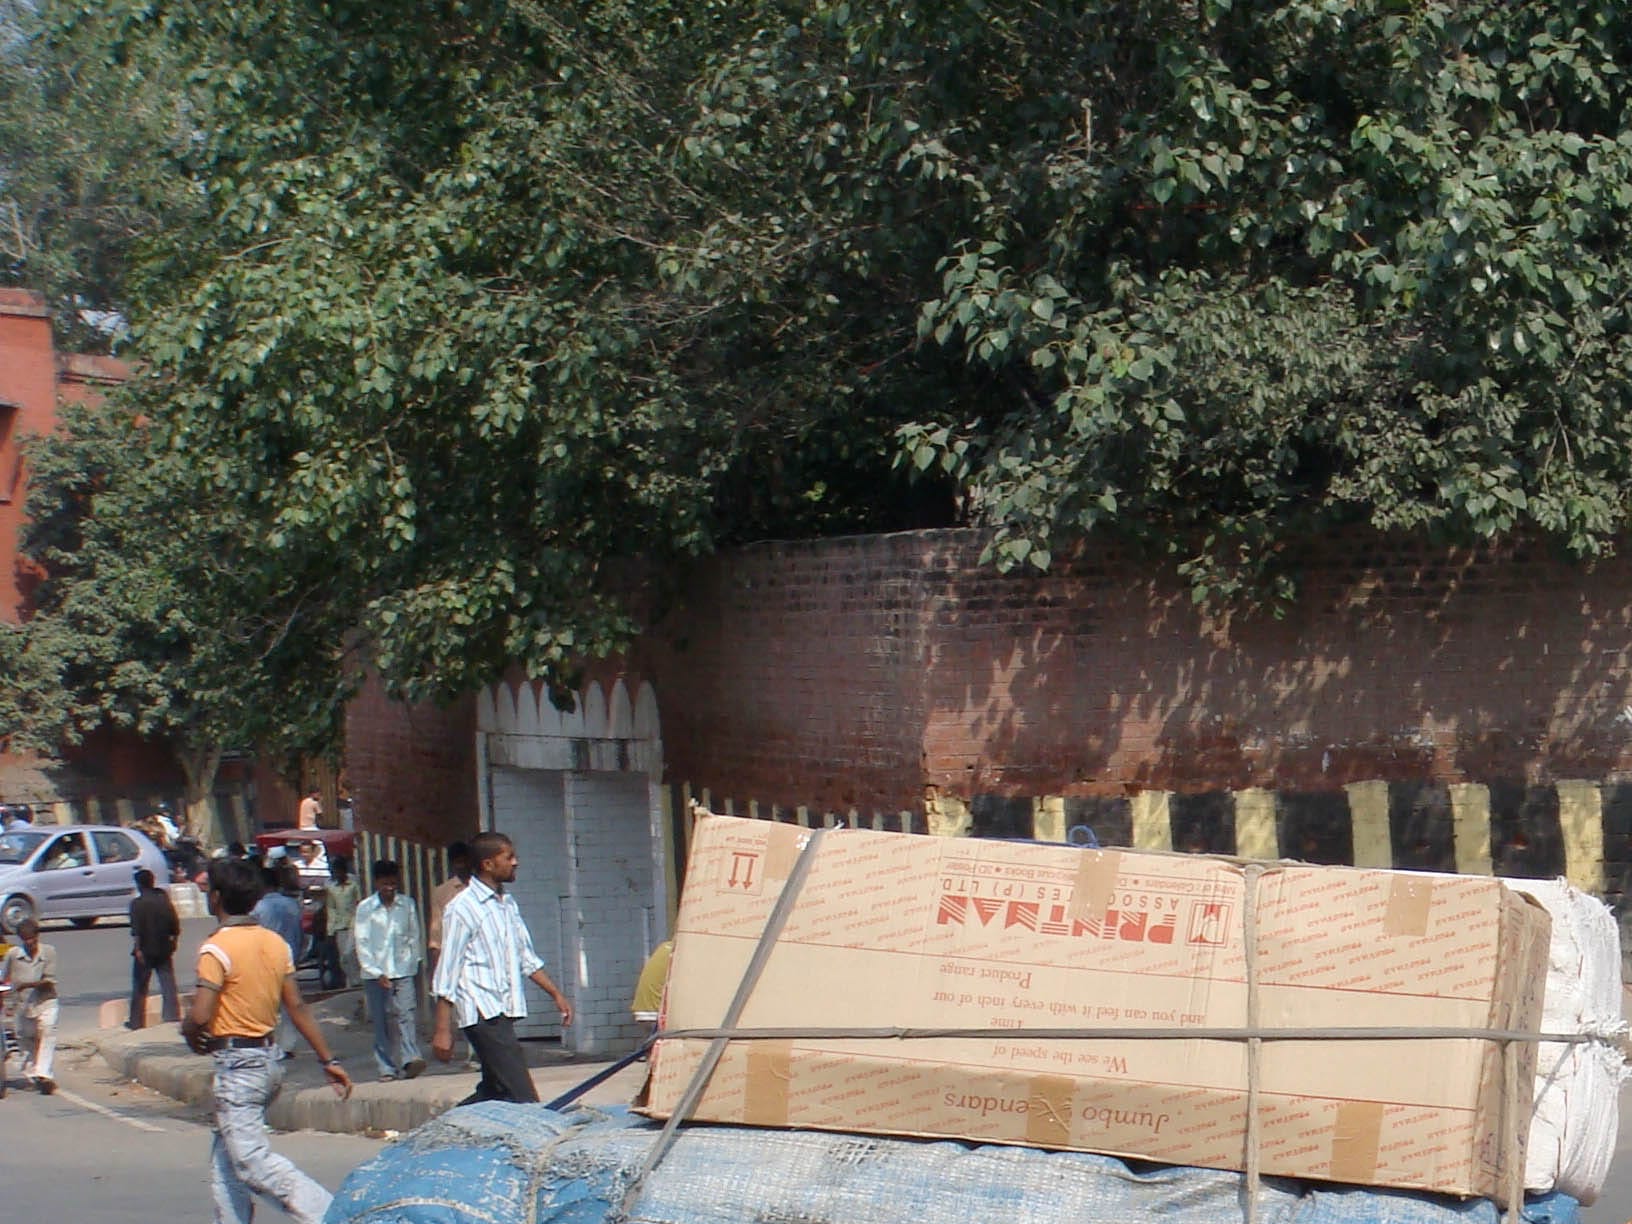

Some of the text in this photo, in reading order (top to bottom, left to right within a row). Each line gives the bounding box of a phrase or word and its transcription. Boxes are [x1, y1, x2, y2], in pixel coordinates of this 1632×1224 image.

[992, 882, 1024, 896] (P)
[1037, 886, 1179, 910] ASSOCTES
[936, 895, 1176, 944] PRINTMAN
[940, 964, 1032, 989] Product range
[933, 991, 955, 1003] our
[958, 994, 973, 1007] of
[977, 995, 1006, 1011] inch
[1011, 996, 1044, 1012] every
[1048, 1002, 1076, 1016] with
[1096, 1007, 1120, 1022] feel
[1124, 1008, 1147, 1020] can
[1152, 1009, 1176, 1023] you
[1180, 1013, 1204, 1027] and
[1011, 1044, 1048, 1064] speed
[1052, 1051, 1072, 1068] the
[1078, 1053, 1099, 1065] see
[1102, 1054, 1128, 1074] We
[943, 1092, 1170, 1134] Jumbo endars
